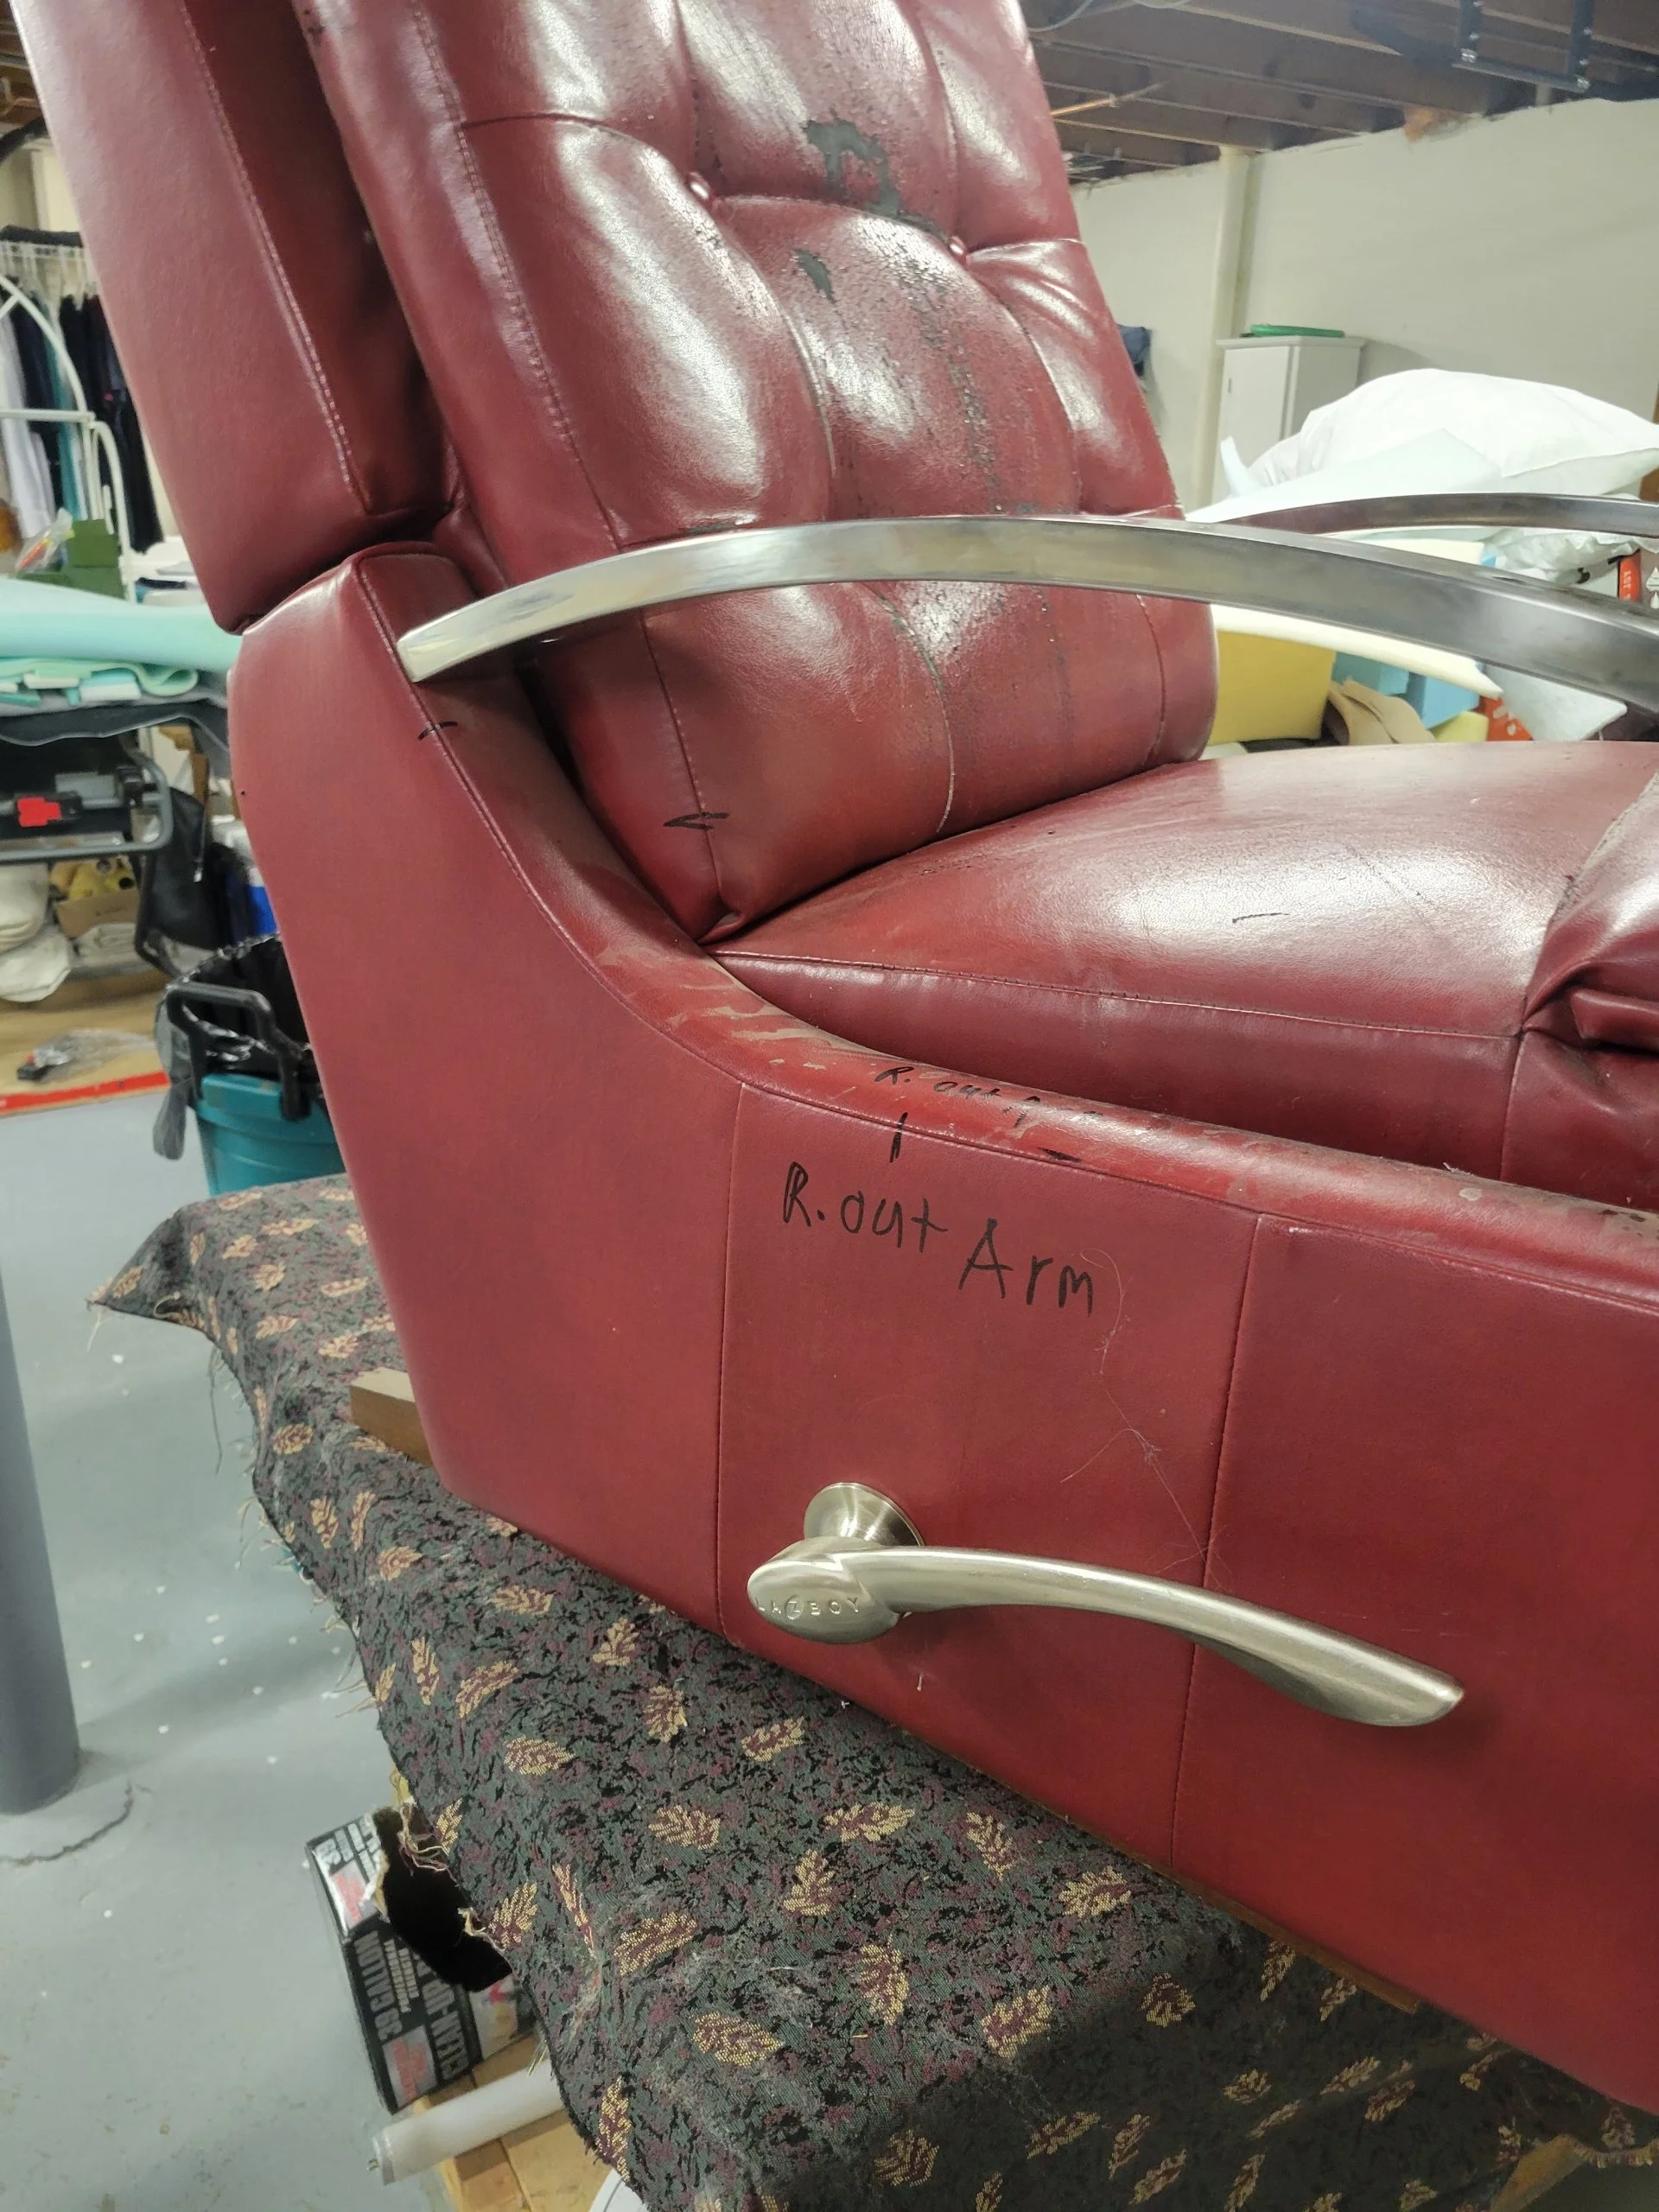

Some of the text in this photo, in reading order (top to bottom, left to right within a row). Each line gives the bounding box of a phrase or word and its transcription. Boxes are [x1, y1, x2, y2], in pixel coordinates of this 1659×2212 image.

[783, 1160, 1094, 1318] R. out Arm
[353, 1929, 404, 2041] 39 GALLON
[420, 1975, 470, 2080] CLEAN-UP
